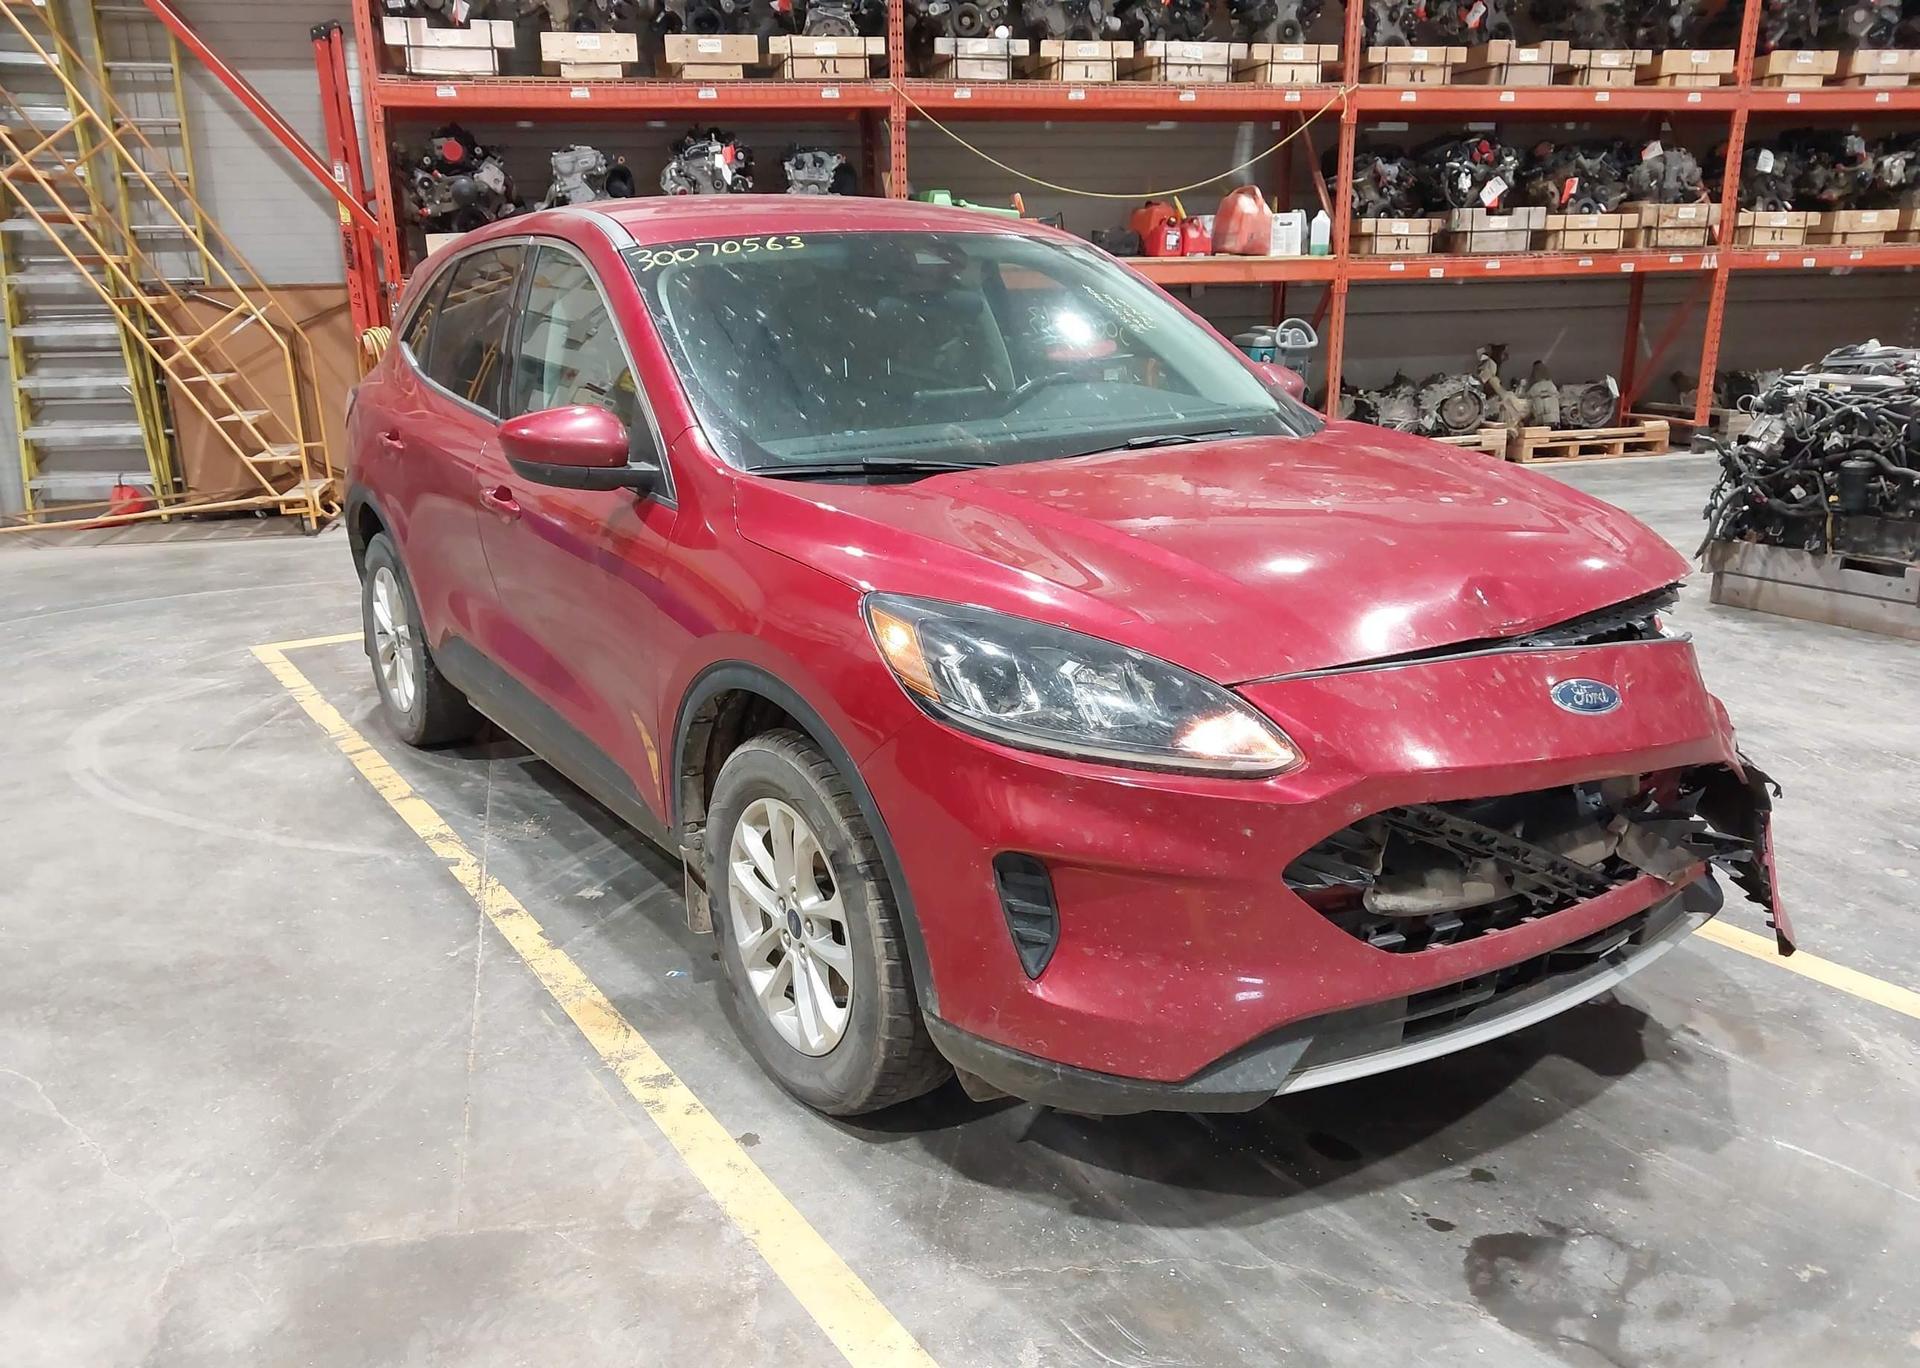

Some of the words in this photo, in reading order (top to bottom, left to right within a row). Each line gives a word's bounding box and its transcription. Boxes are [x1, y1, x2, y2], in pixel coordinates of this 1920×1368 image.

[630, 236, 805, 271] 30070563
[1701, 254, 1718, 269] AA
[1571, 684, 1609, 705] Ford
